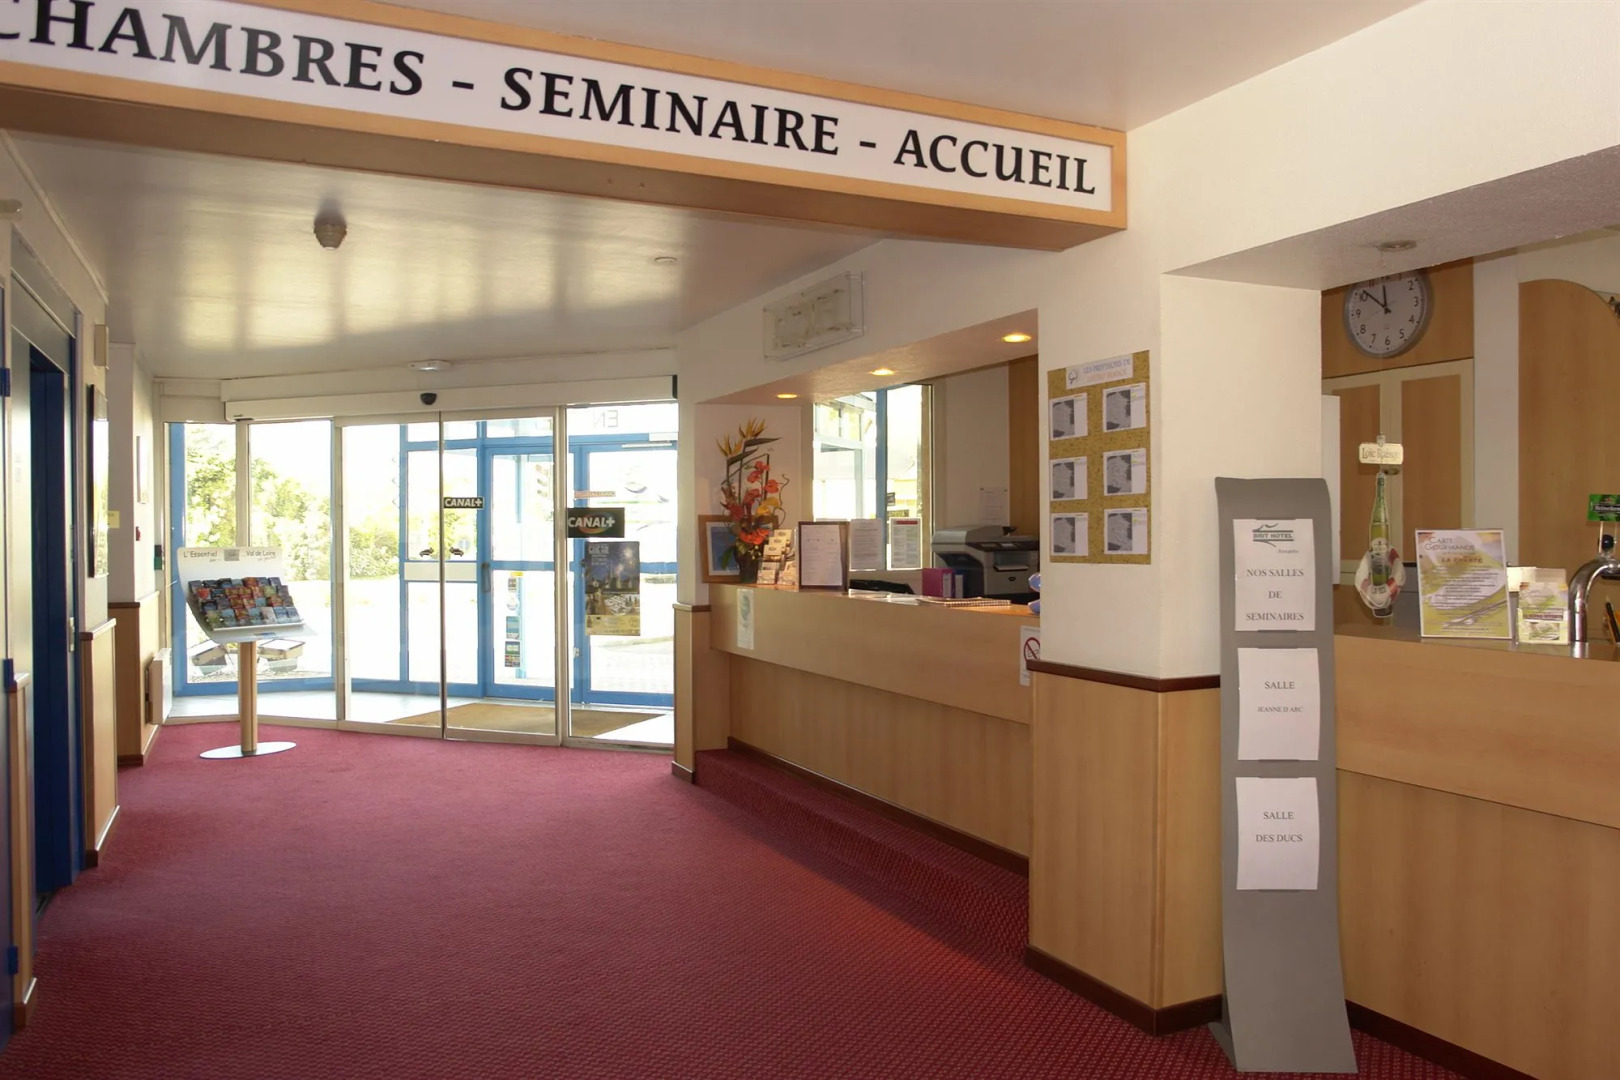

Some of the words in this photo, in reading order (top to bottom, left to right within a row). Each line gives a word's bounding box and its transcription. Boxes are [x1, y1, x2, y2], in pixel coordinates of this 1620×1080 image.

[500, 67, 839, 156] SEMINAIRE
[893, 129, 1096, 195] ACCUEIL
[1408, 280, 1414, 291] 2
[1413, 296, 1419, 307] 3
[1355, 309, 1361, 318] 9
[1408, 315, 1414, 324] 4
[1360, 324, 1366, 334] 8
[1399, 328, 1404, 339] 5
[1371, 333, 1376, 344] 7
[1384, 336, 1390, 346] 6
[444, 498, 483, 507] CANAL+
[567, 515, 616, 528] CANAL+
[1246, 569, 1267, 577] NOS
[1269, 569, 1304, 577] SALLES
[1268, 591, 1282, 599] DE
[1246, 613, 1304, 621] SEMINAIRES
[1264, 681, 1295, 689] SALLE
[1263, 811, 1294, 820] SALLE
[1256, 834, 1275, 843] DES
[1276, 834, 1304, 843] DUCS
